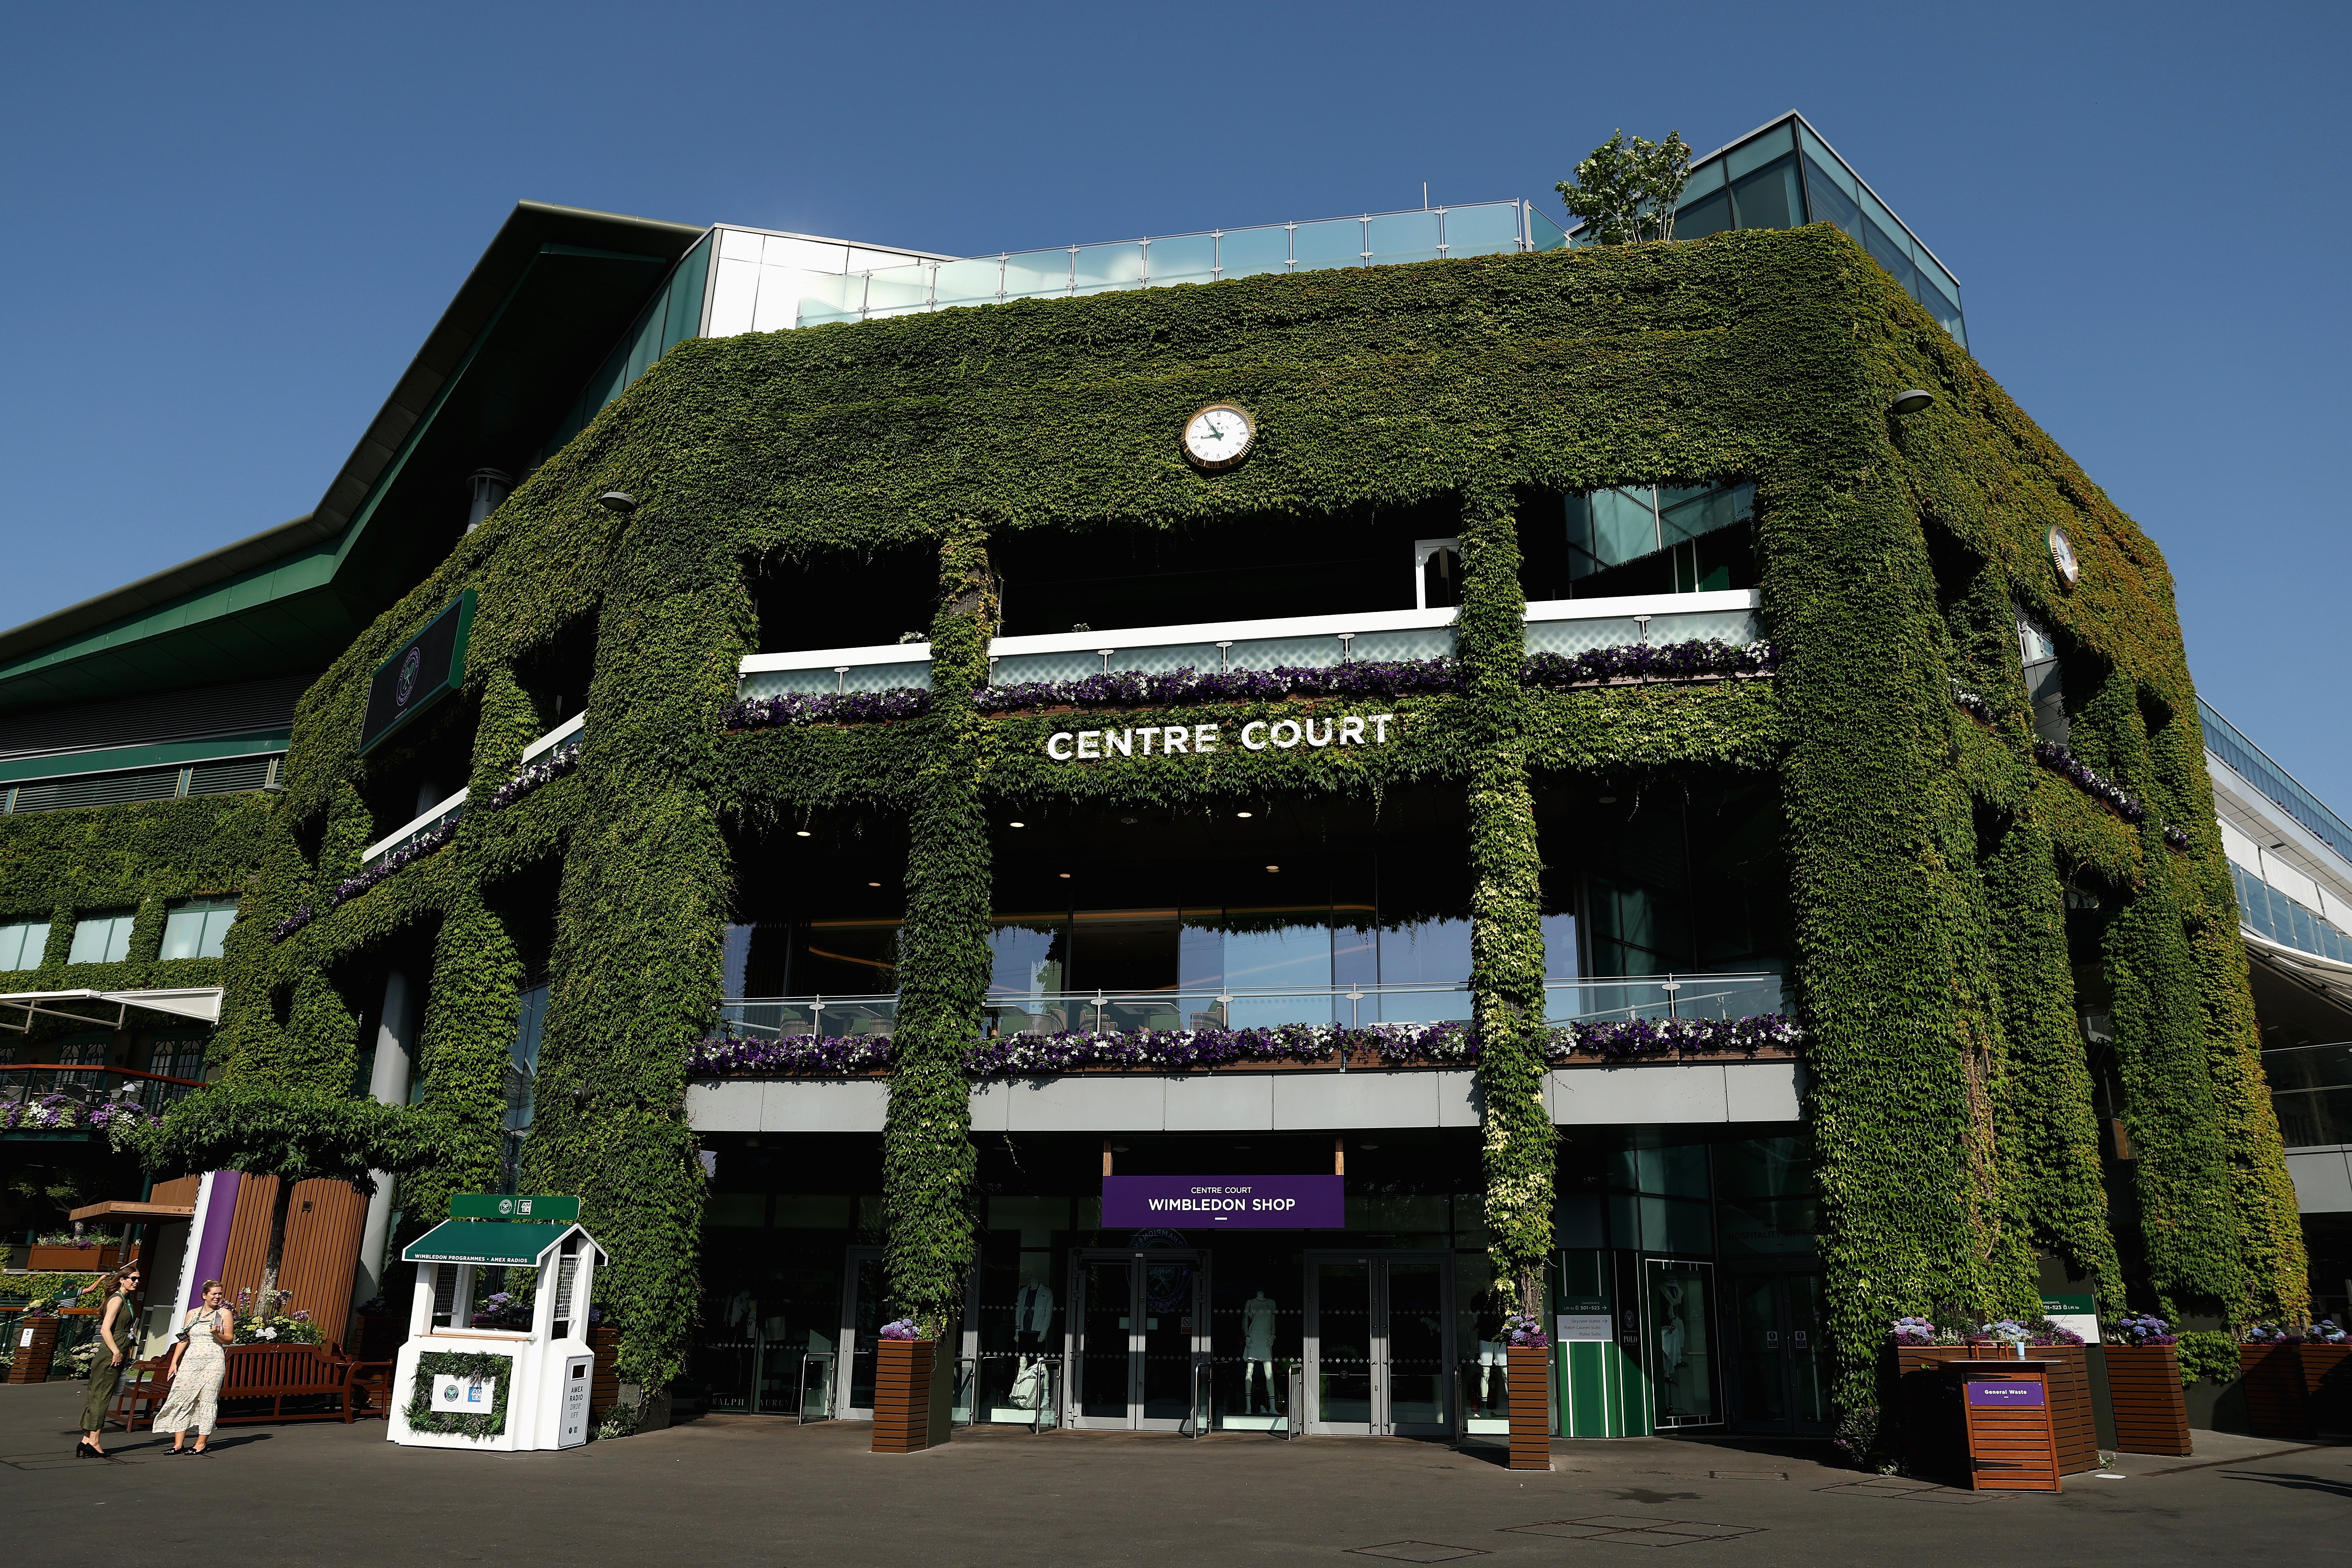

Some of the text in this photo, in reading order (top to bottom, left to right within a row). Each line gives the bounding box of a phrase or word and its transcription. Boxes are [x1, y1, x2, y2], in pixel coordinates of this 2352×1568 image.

[1048, 714, 1393, 760] CENTRE COURT
[1148, 1198, 1295, 1211] WIMBLEDON SHOP
[1729, 1230, 1781, 1240] HOSPITALITY
[712, 1398, 745, 1406] RALPH
[759, 1398, 789, 1407] AUREN
